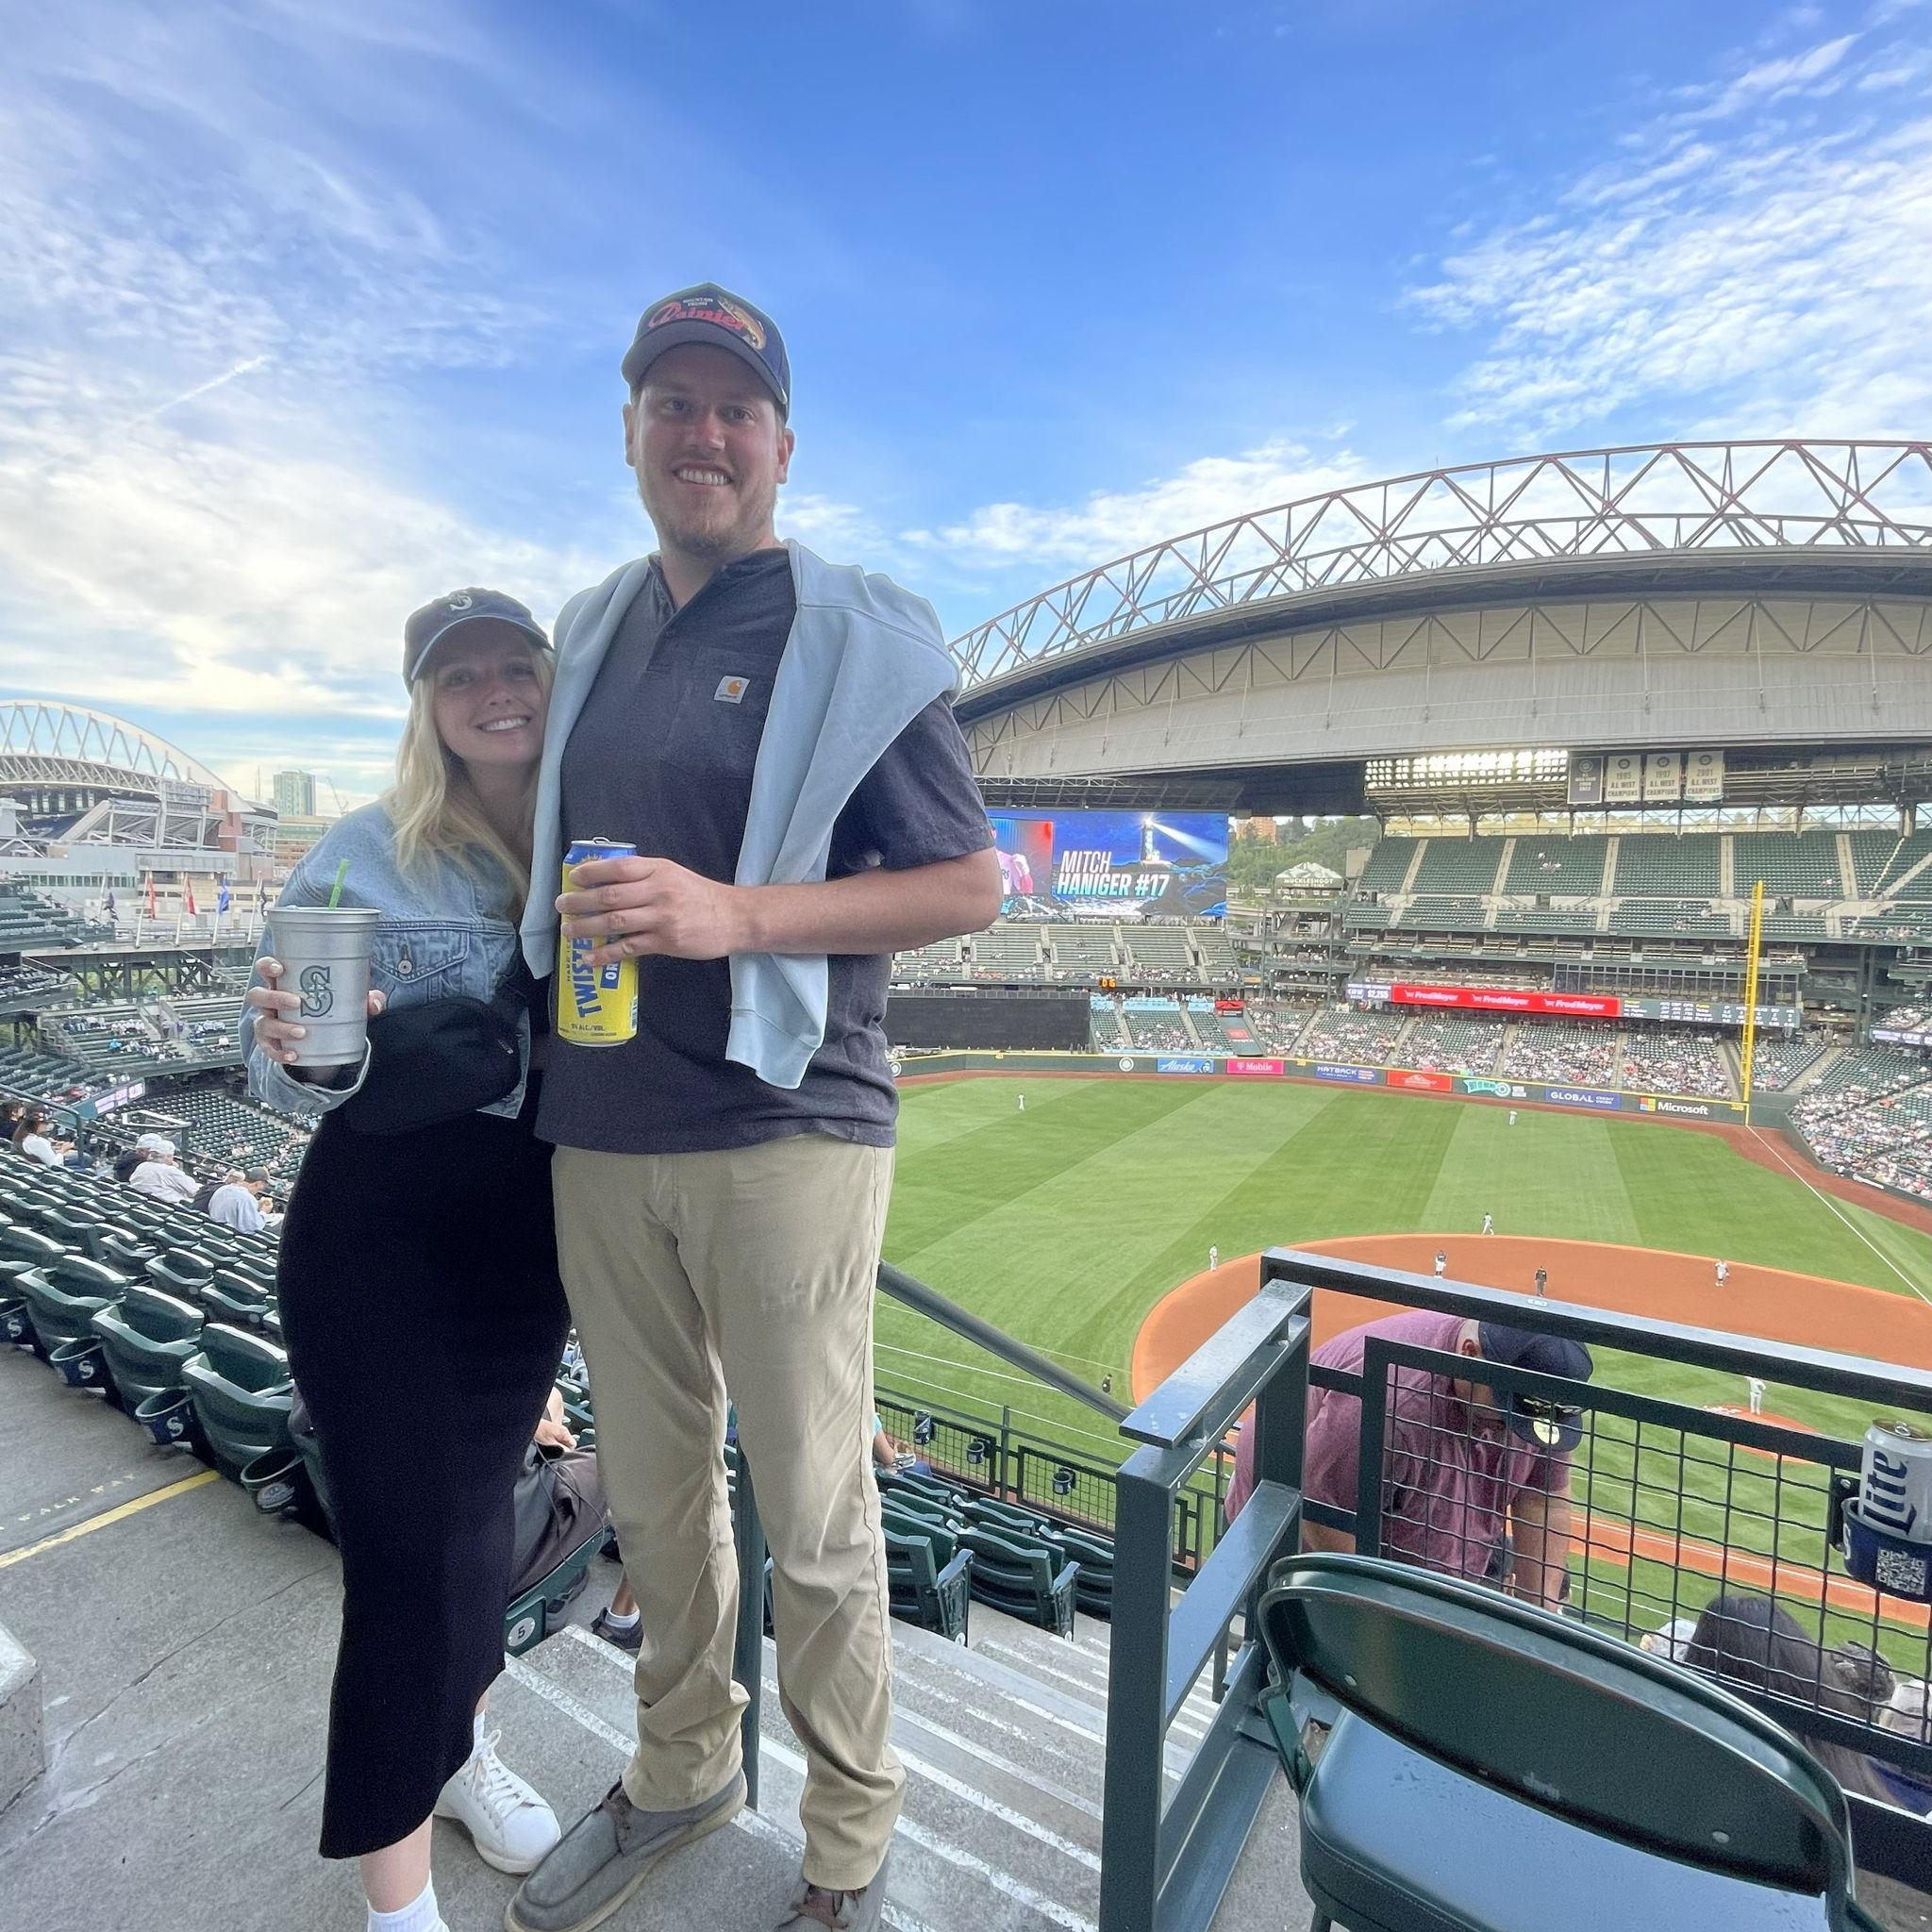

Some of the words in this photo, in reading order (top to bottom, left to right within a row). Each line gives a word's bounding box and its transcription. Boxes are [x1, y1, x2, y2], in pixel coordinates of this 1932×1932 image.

[1059, 850, 1112, 874] MITCH
[1057, 873, 1132, 896] HANIGER
[1134, 874, 1171, 897] #17
[300, 965, 333, 1018] S
[1160, 1059, 1196, 1073] Alaska
[1550, 1091, 1594, 1104] GLOBAL
[1657, 1101, 1709, 1116] Microsoft
[1862, 1450, 1918, 1537] Lite
[517, 1625, 526, 1640] 5
